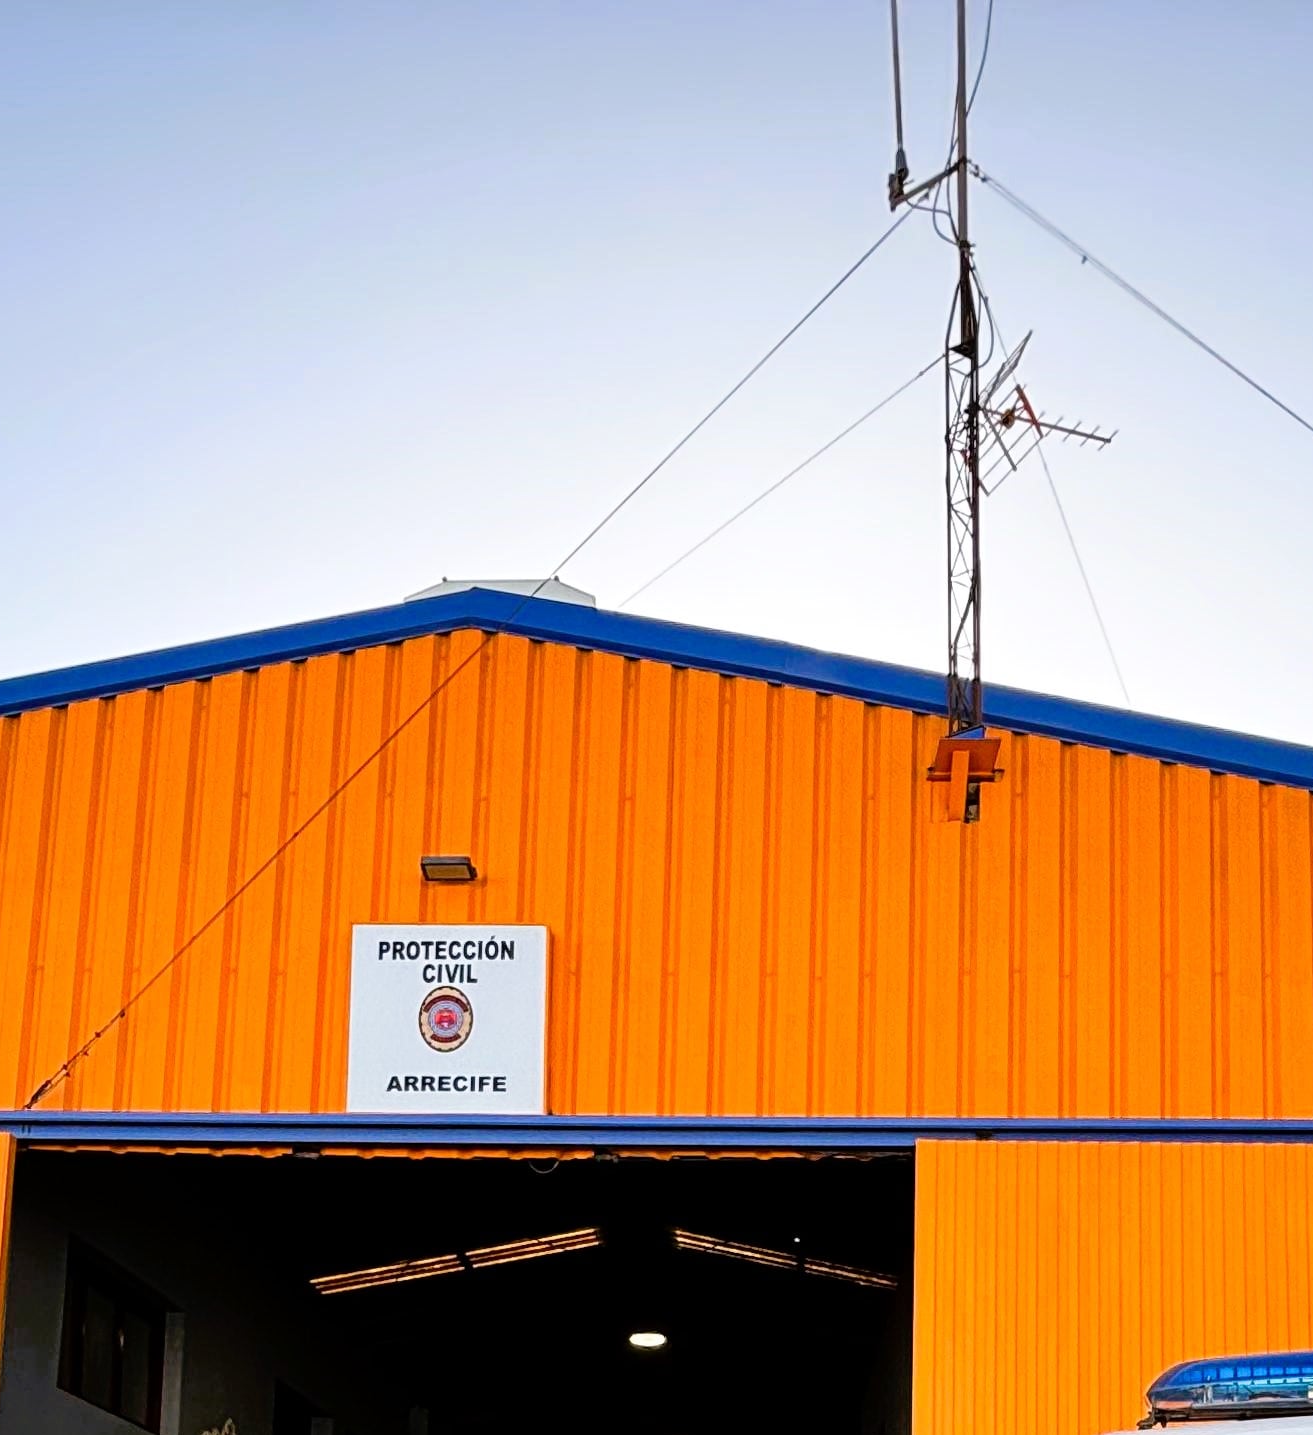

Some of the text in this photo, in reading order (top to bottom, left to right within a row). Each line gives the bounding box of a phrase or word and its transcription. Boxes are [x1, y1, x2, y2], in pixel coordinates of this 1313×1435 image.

[378, 936, 515, 960] PROTECCIÓN
[423, 964, 478, 983] CIVIL
[386, 1076, 507, 1092] ARRECIFE
